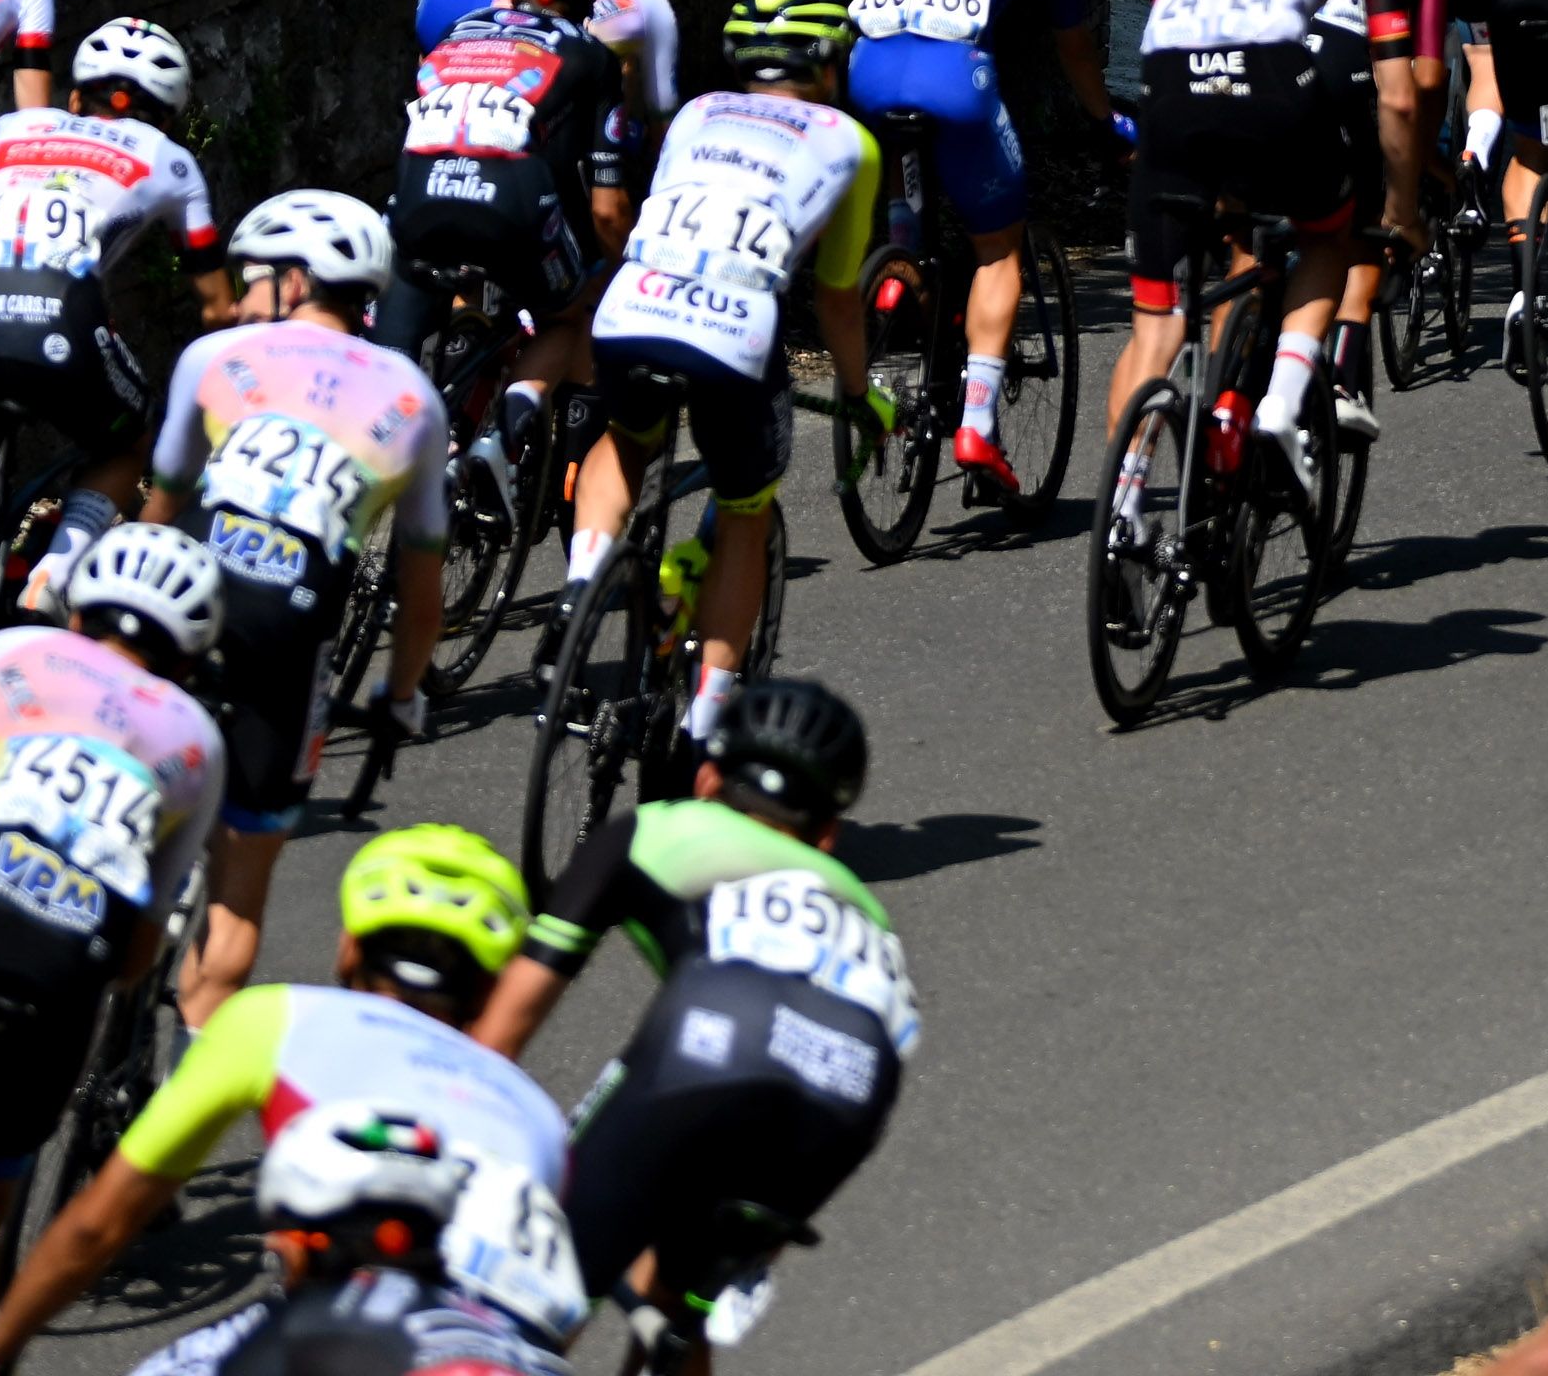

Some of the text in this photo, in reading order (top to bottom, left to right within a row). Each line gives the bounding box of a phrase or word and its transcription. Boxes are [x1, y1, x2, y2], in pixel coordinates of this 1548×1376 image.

[1189, 51, 1245, 75] UAE
[477, 83, 521, 123] 44
[427, 171, 497, 202] italia
[432, 157, 481, 175] selle
[46, 198, 88, 246] 91
[657, 193, 772, 260] 14 14
[209, 424, 302, 478] 142
[210, 509, 308, 580] VPM
[4, 737, 153, 849] 145 14
[736, 879, 828, 935] 165
